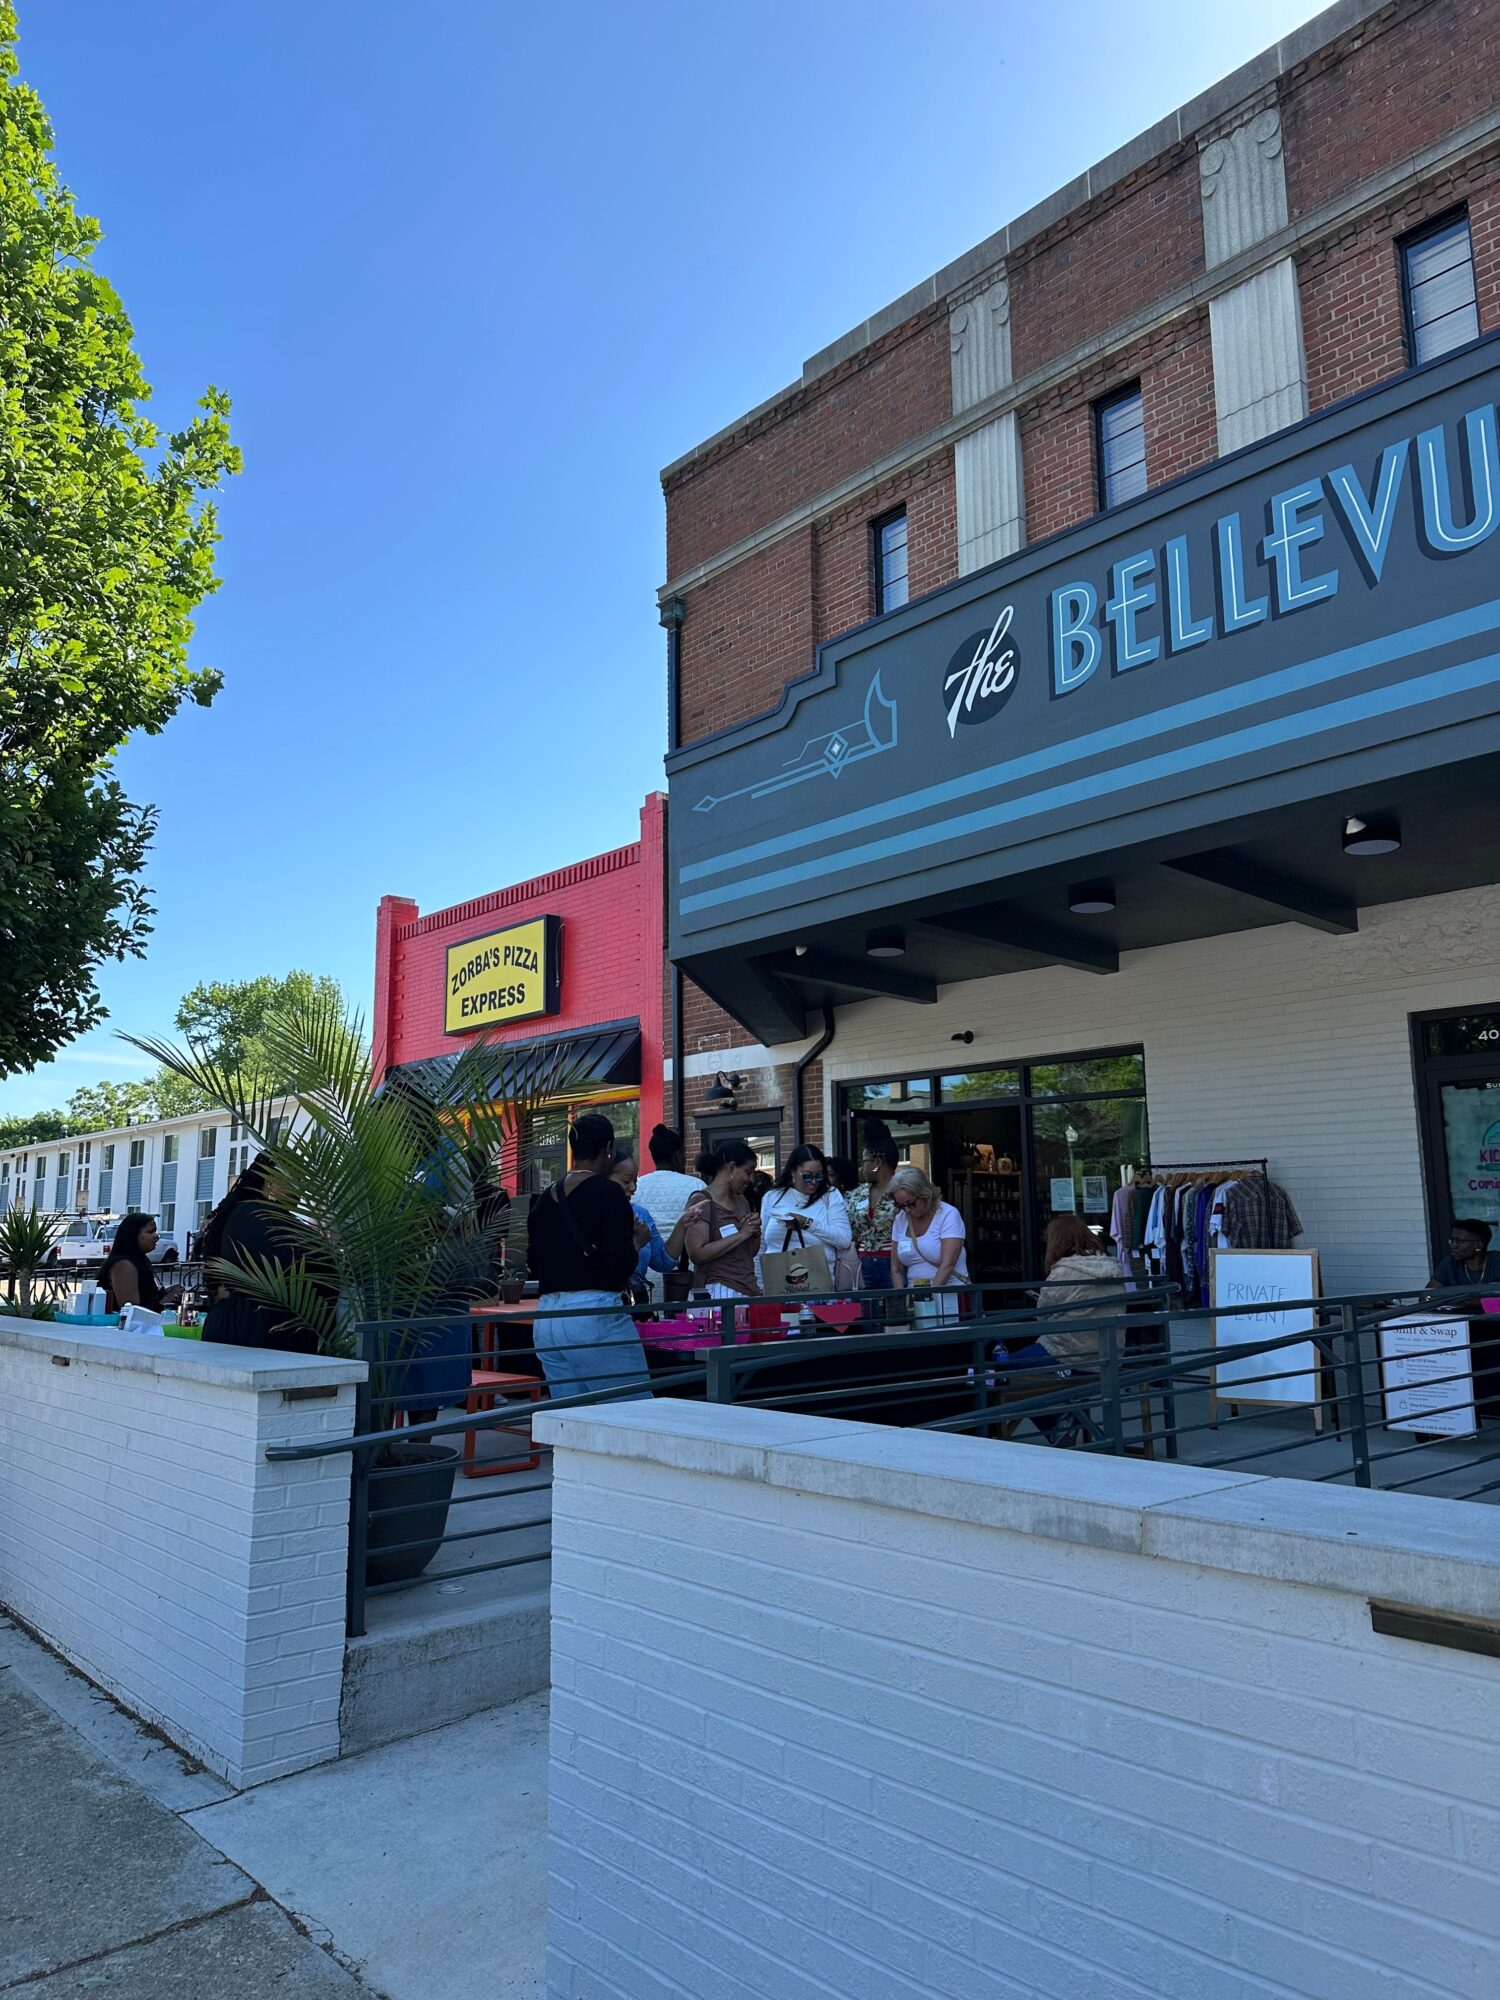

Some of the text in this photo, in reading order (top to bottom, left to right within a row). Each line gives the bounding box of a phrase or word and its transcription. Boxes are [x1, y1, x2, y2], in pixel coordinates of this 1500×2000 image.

[1047, 403, 1500, 696] BELLEVU
[451, 945, 538, 995] ZORBA'S PIZZA
[461, 983, 525, 1017] EXPRESS
[1430, 1326, 1458, 1338] Swap
